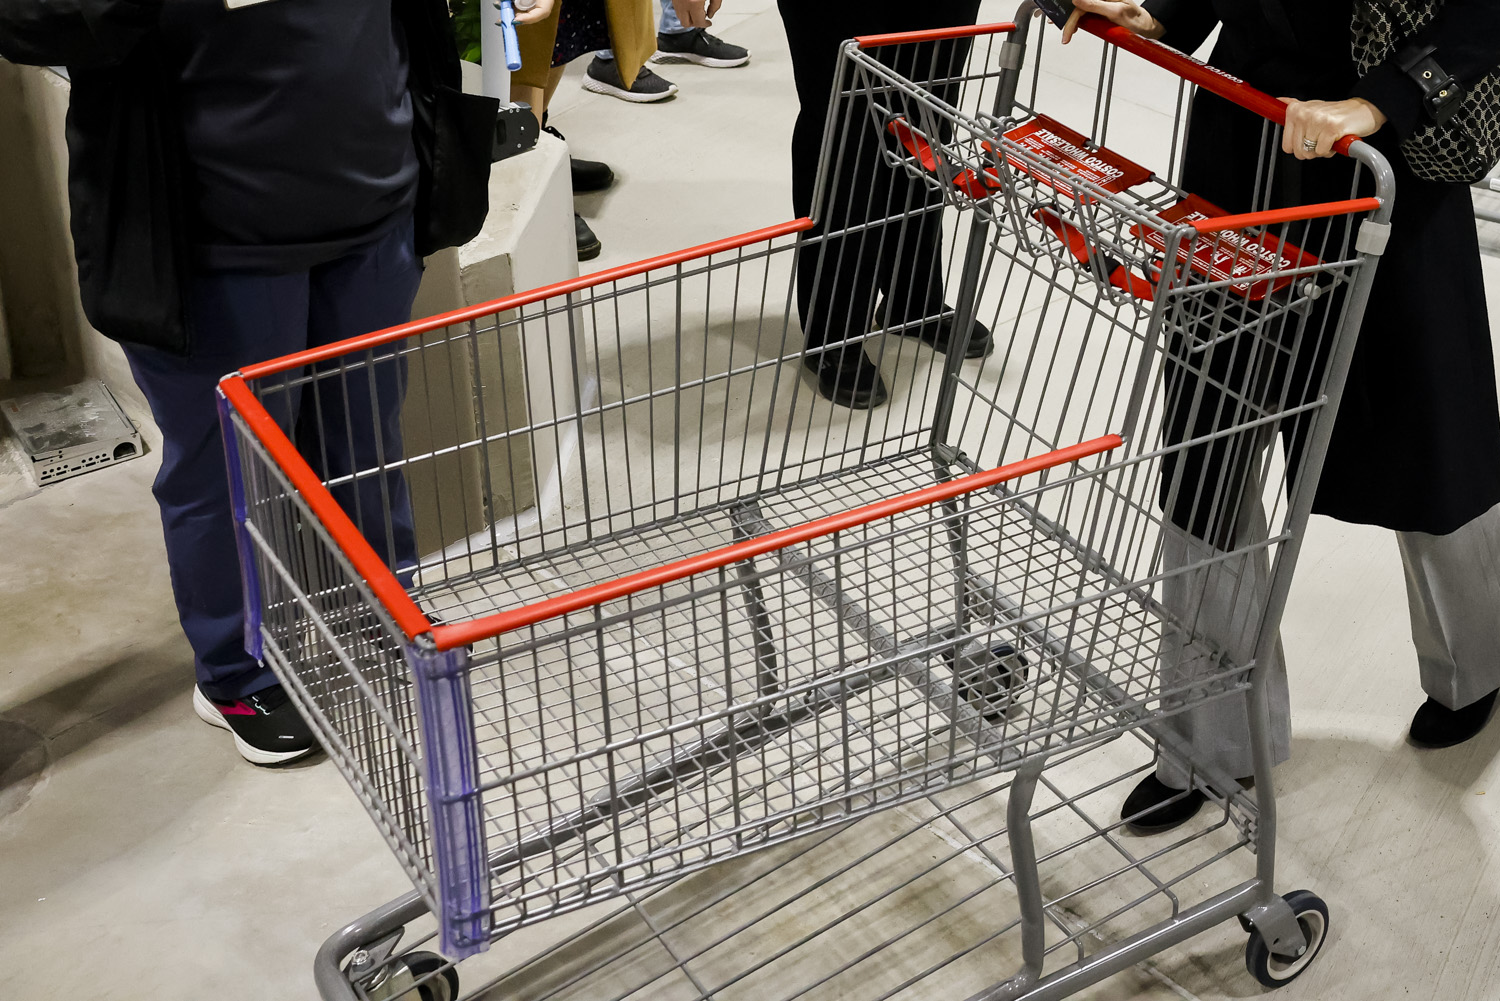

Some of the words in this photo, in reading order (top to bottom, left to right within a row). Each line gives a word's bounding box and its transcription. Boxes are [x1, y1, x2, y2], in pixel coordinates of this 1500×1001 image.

[1204, 65, 1243, 83] COSTCO
[1034, 128, 1089, 162] WHOLESALE
[1086, 156, 1125, 179] COSTCO
